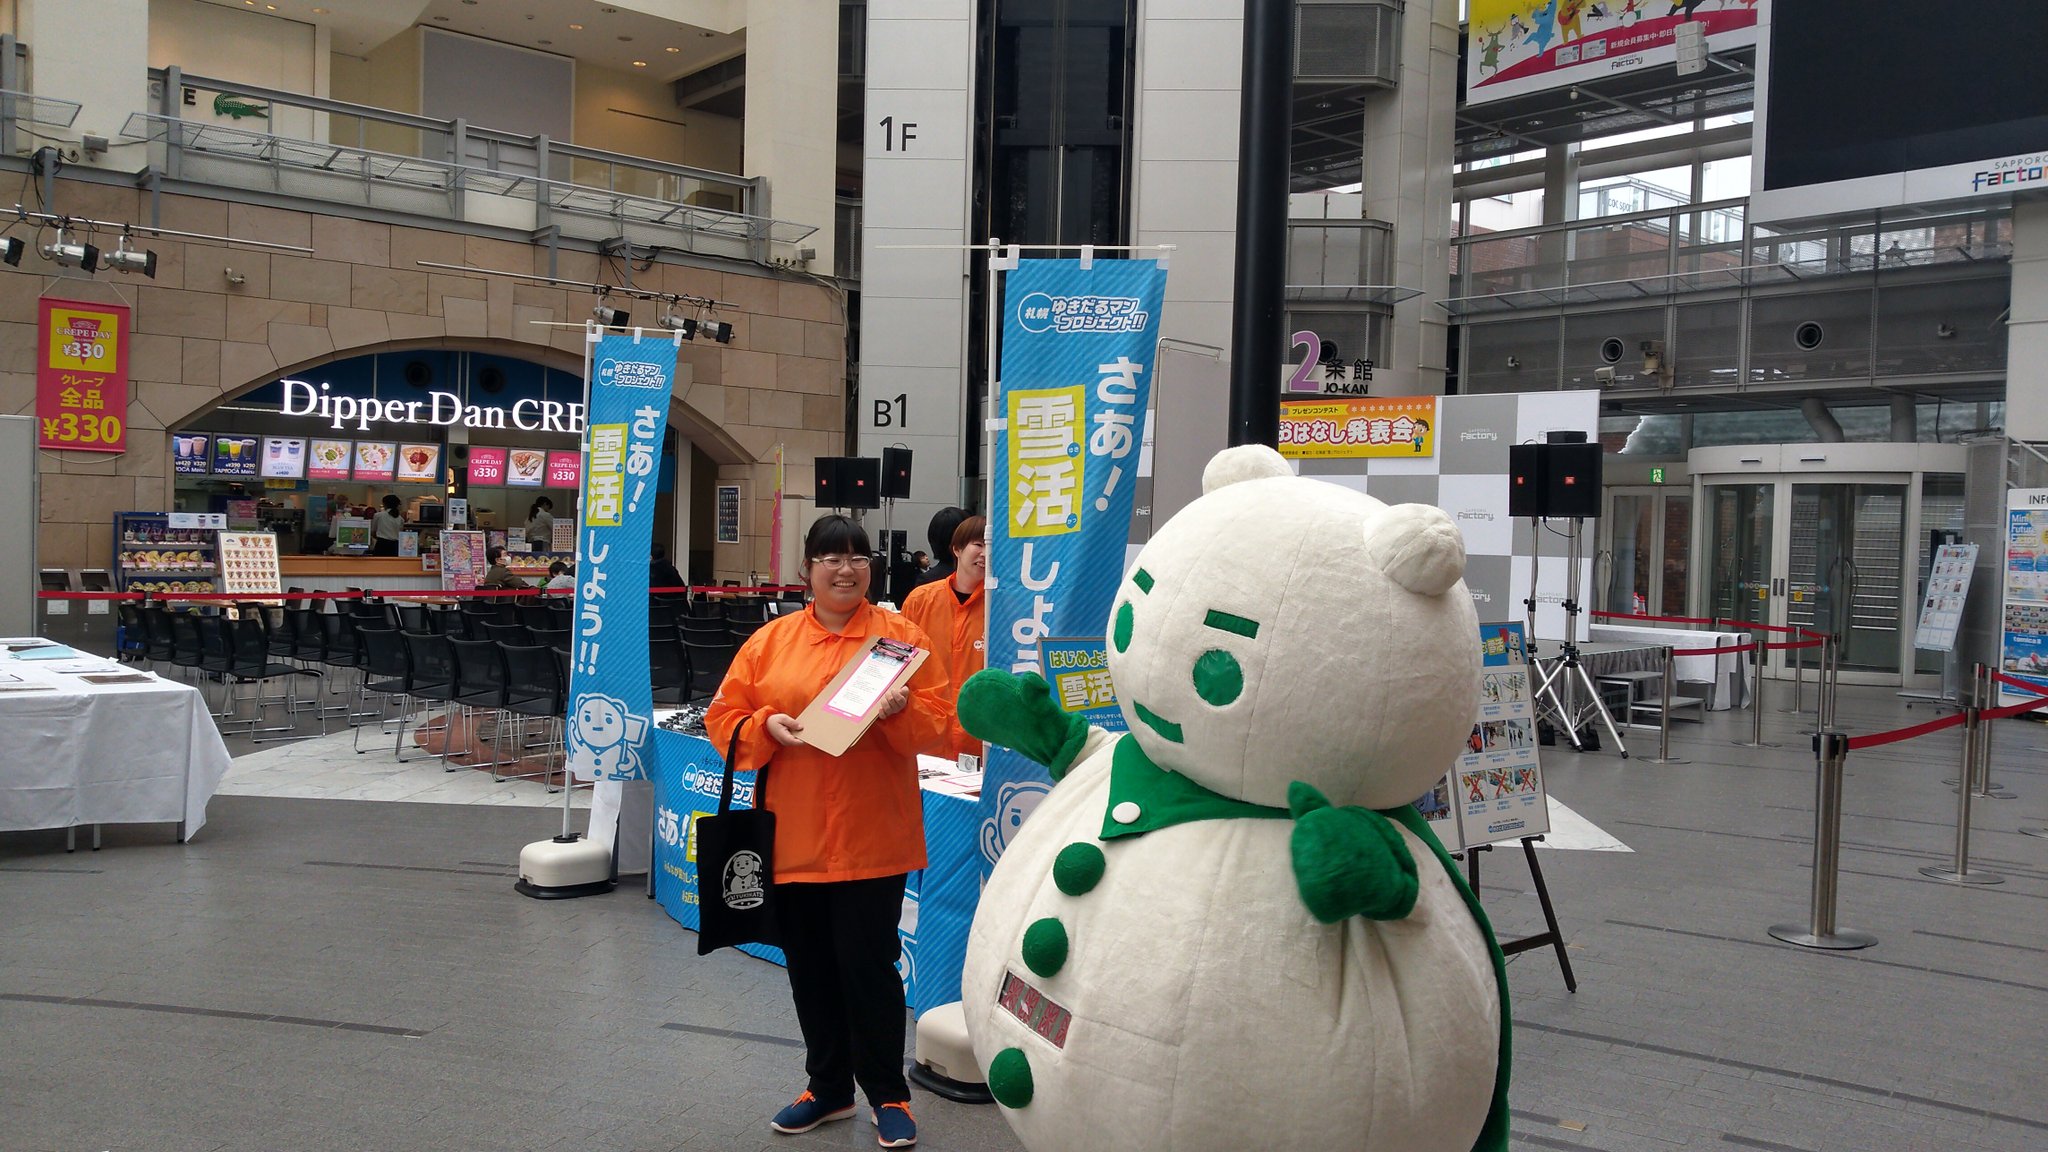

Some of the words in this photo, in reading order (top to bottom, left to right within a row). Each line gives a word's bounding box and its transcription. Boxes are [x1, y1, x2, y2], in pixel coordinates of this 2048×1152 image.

[880, 116, 917, 151] 1F
[1025, 307, 1050, 320] 札幌
[1052, 298, 1138, 316] ゆきだるマン
[56, 327, 91, 338] CREPE
[91, 330, 112, 339] DAY
[63, 342, 105, 359] ¥330
[1289, 330, 1321, 393] 2
[1325, 359, 1374, 381] 条館
[60, 374, 105, 387] クレープ
[1323, 382, 1369, 394] JO-KAN
[60, 387, 104, 409] 全品
[279, 378, 423, 430] Dipper
[428, 390, 506, 429] Dan
[874, 393, 907, 428] B1
[43, 413, 121, 444] ¥330
[473, 467, 498, 478] ¥330
[552, 471, 576, 481] ¥330
[2029, 493, 2048, 505] INF
[1062, 671, 1115, 708] 雪活
